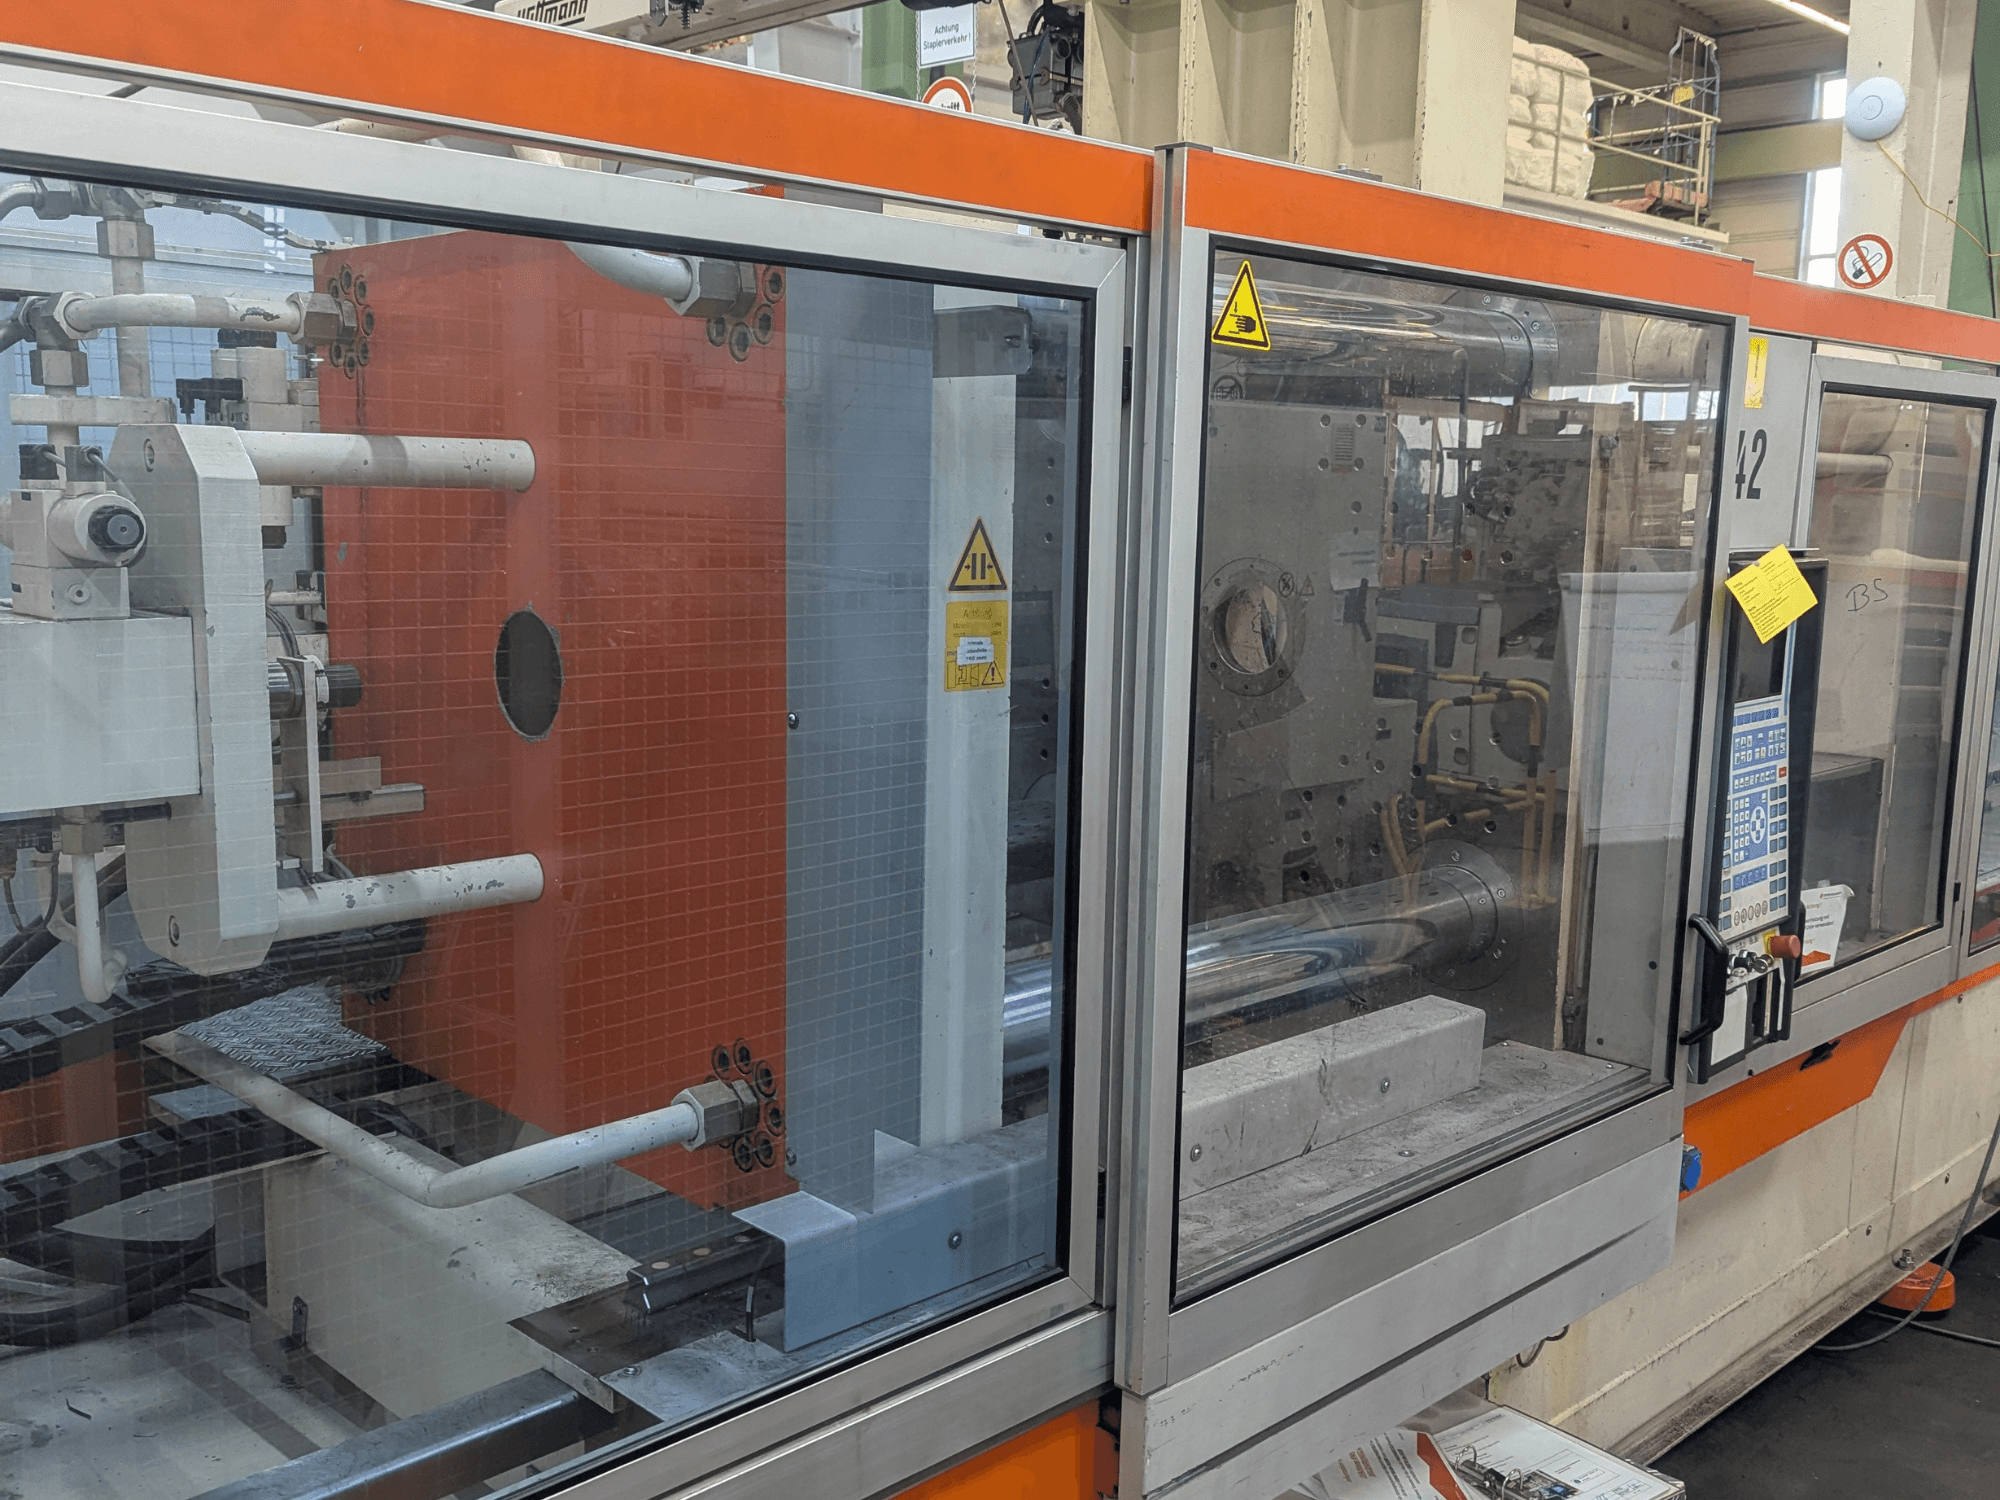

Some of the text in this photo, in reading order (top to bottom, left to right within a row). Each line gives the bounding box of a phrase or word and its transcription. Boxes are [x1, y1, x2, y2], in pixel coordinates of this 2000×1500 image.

[934, 23, 960, 36] Achtung
[1735, 428, 1768, 500] 42
[1845, 577, 1888, 613] BS
